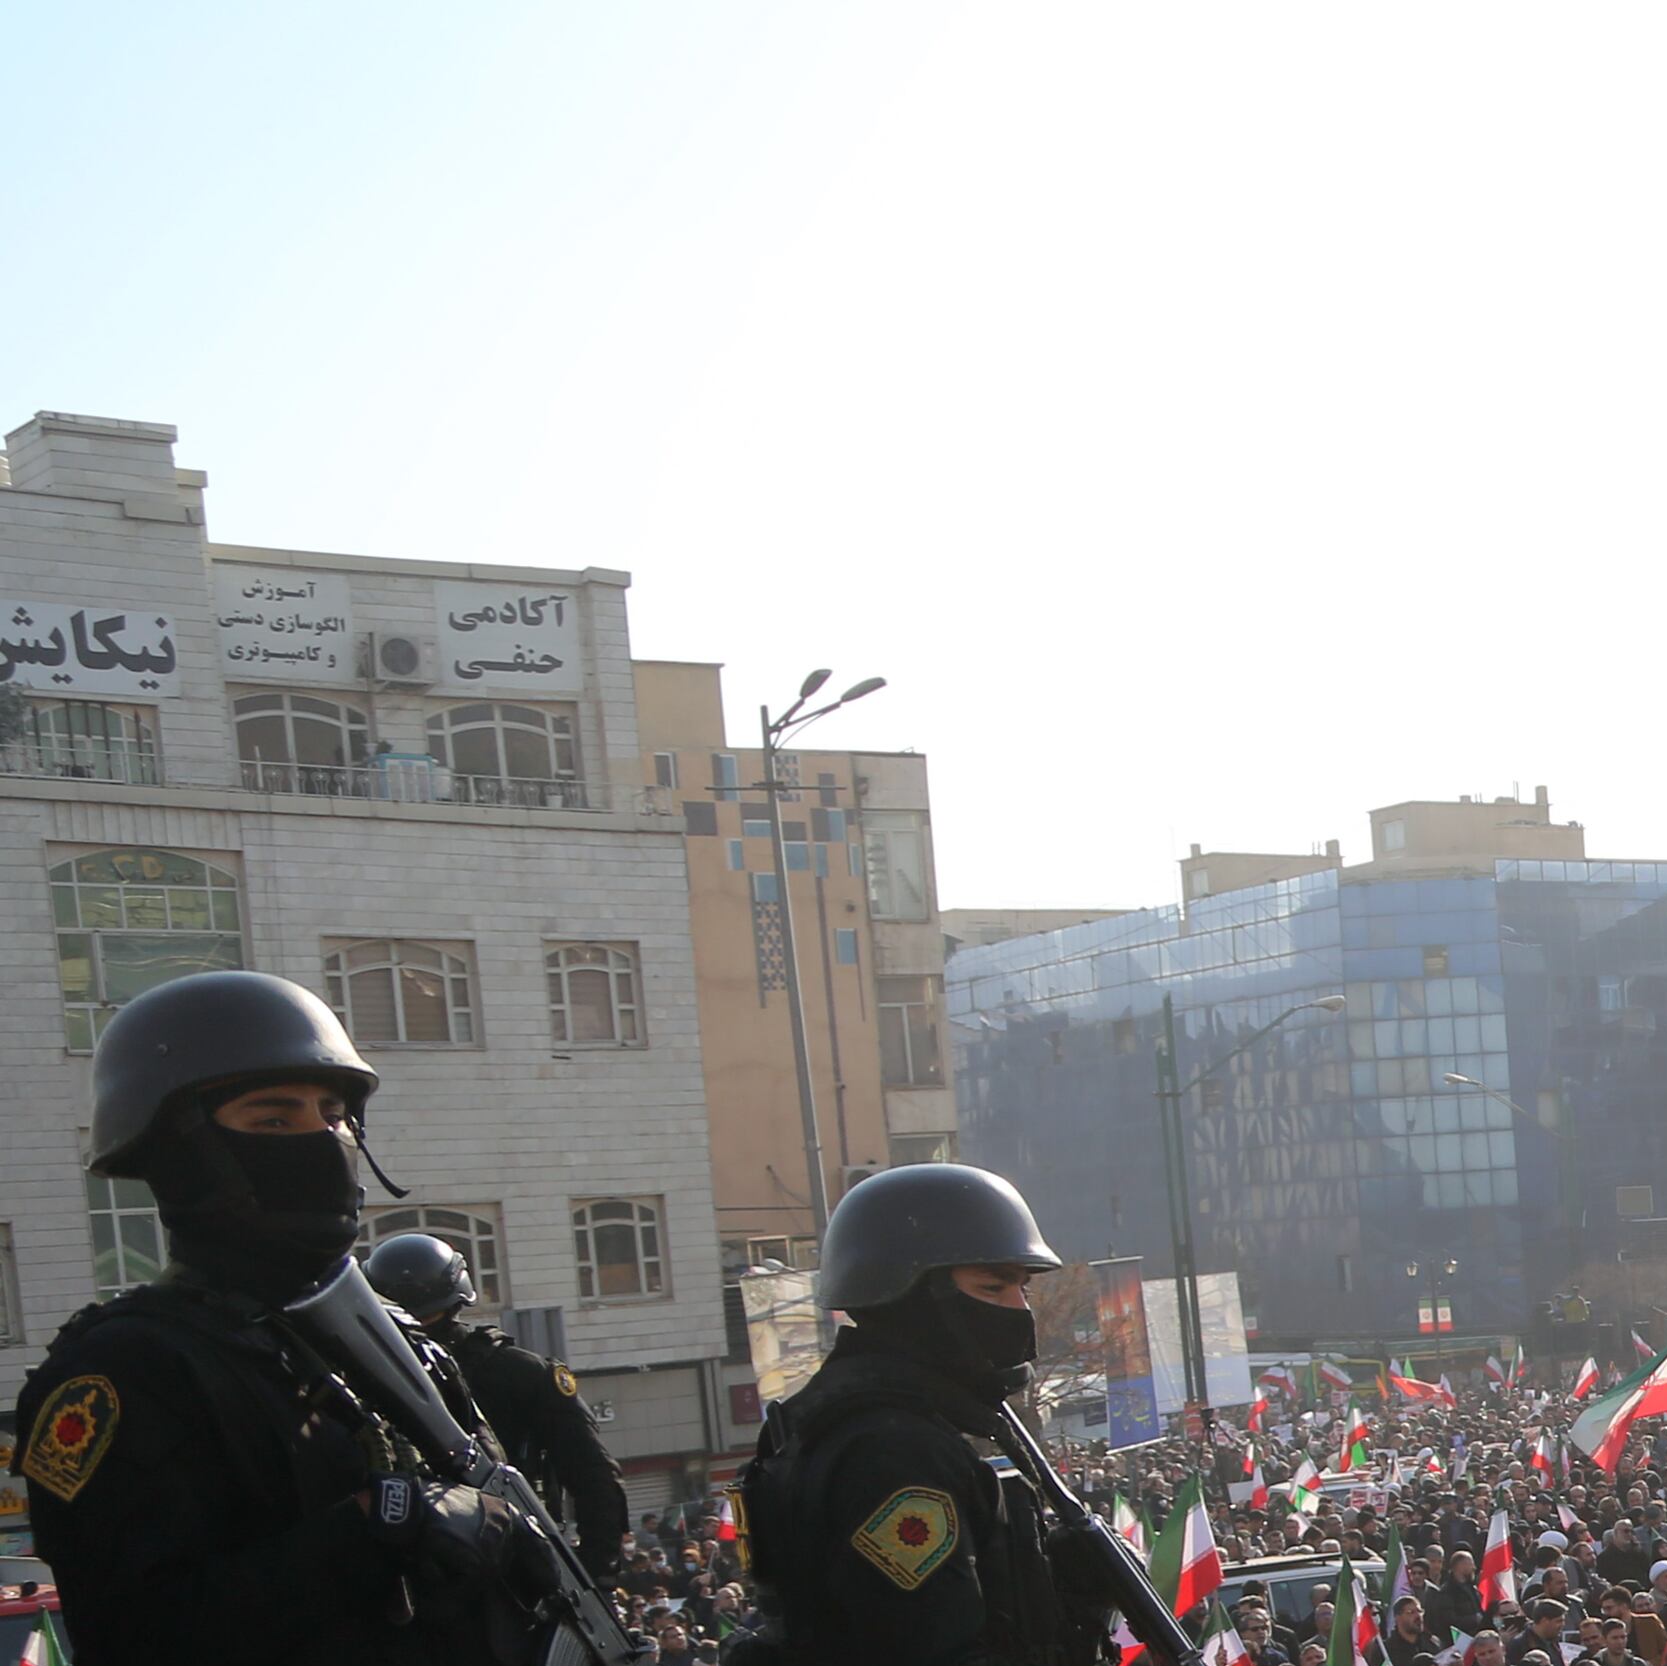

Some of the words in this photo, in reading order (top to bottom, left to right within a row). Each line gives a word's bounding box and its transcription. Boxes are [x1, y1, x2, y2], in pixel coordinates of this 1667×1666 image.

[242, 580, 316, 599] آموزش
[218, 610, 264, 629] دستی
[270, 613, 346, 636] الگوسازی
[449, 595, 568, 632] آکادمی
[228, 641, 322, 664] کامپیوتری
[327, 653, 337, 668] و
[454, 644, 564, 680] حنفی
[385, 1481, 407, 1521] PETZL
